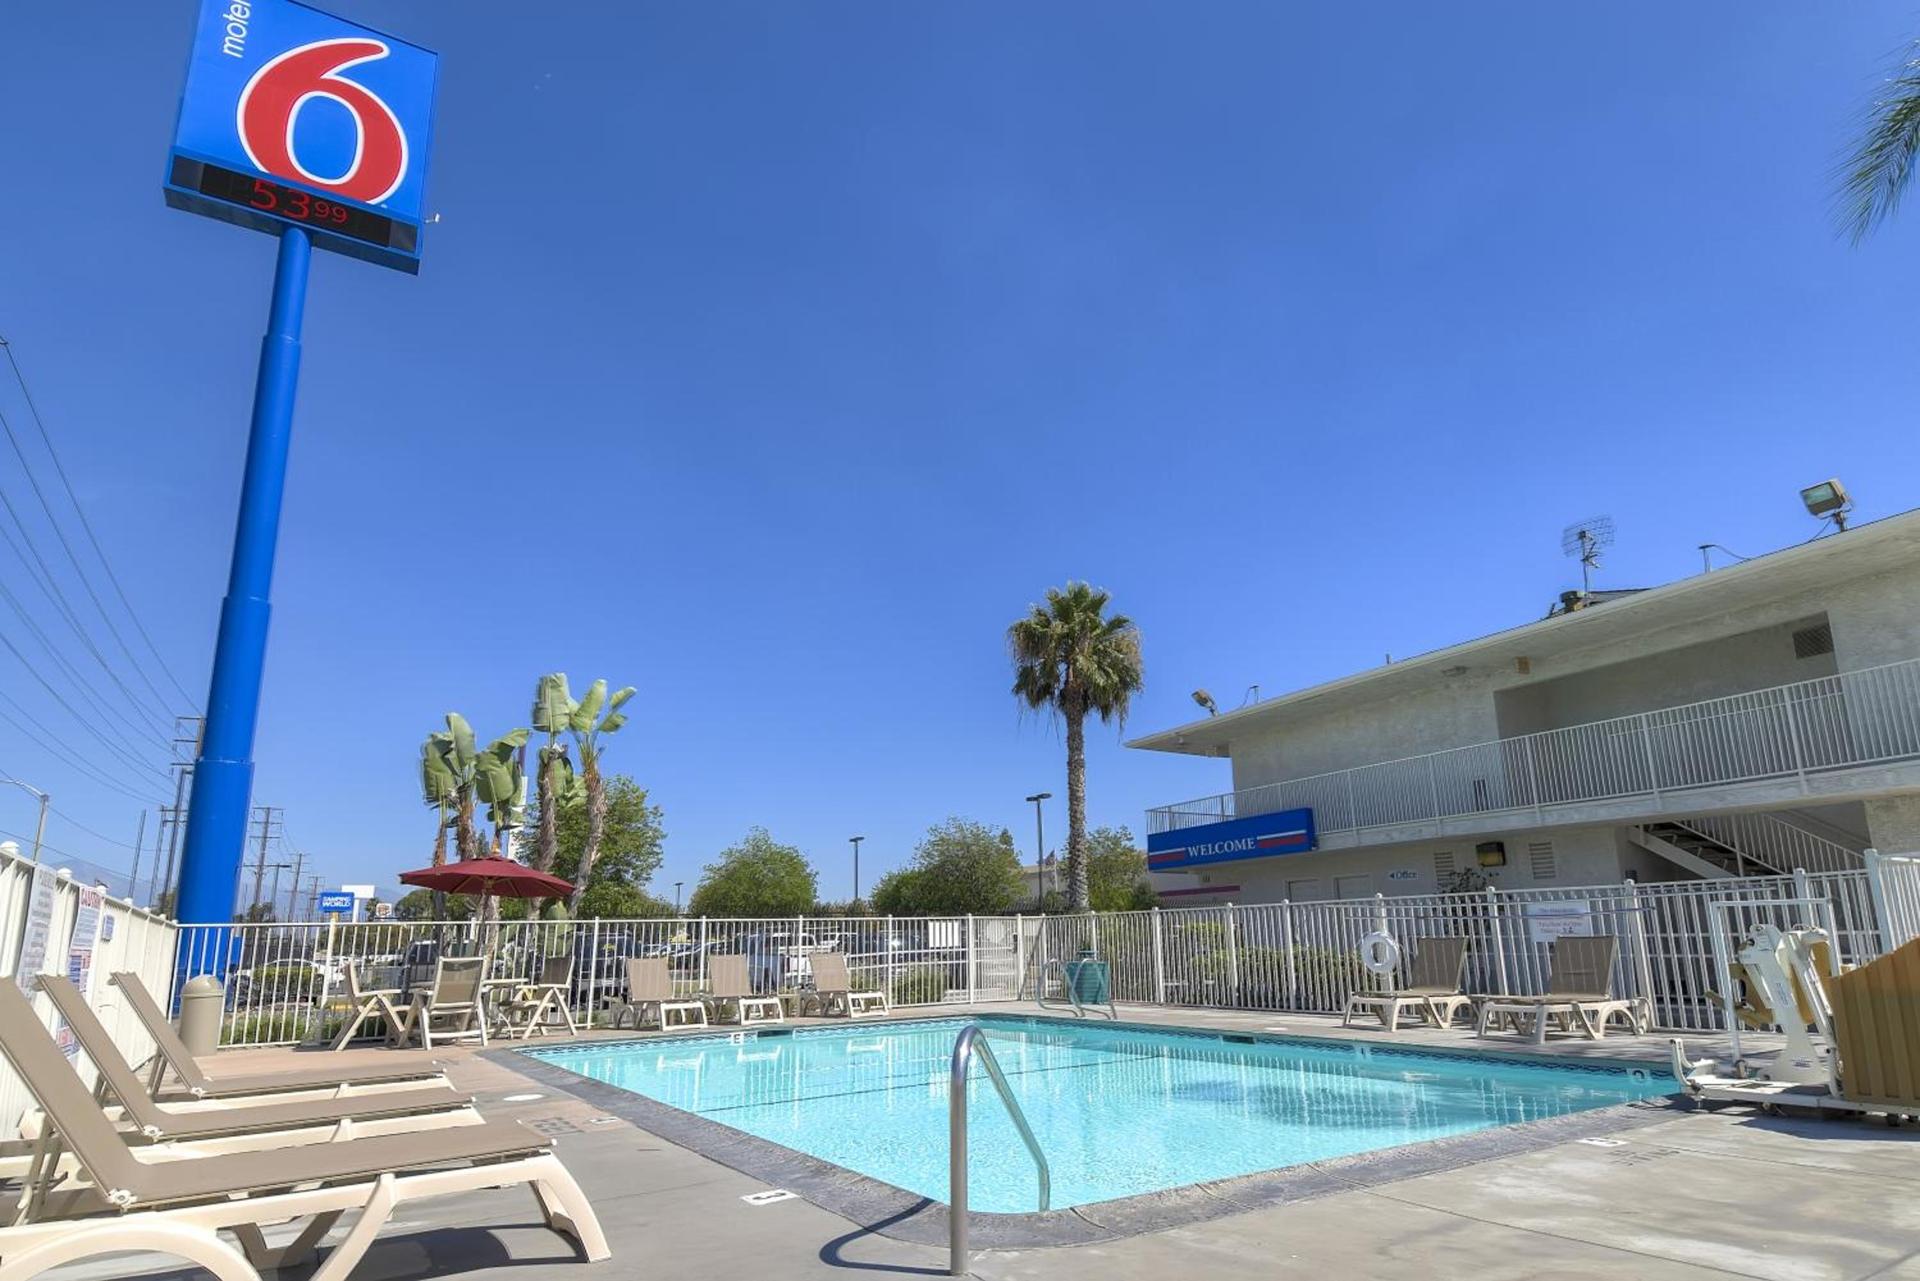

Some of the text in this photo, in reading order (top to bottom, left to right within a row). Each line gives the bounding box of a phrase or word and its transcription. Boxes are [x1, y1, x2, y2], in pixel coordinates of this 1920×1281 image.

[223, 0, 252, 58] motel
[236, 37, 409, 206] 6
[1187, 837, 1256, 858] WELCOME
